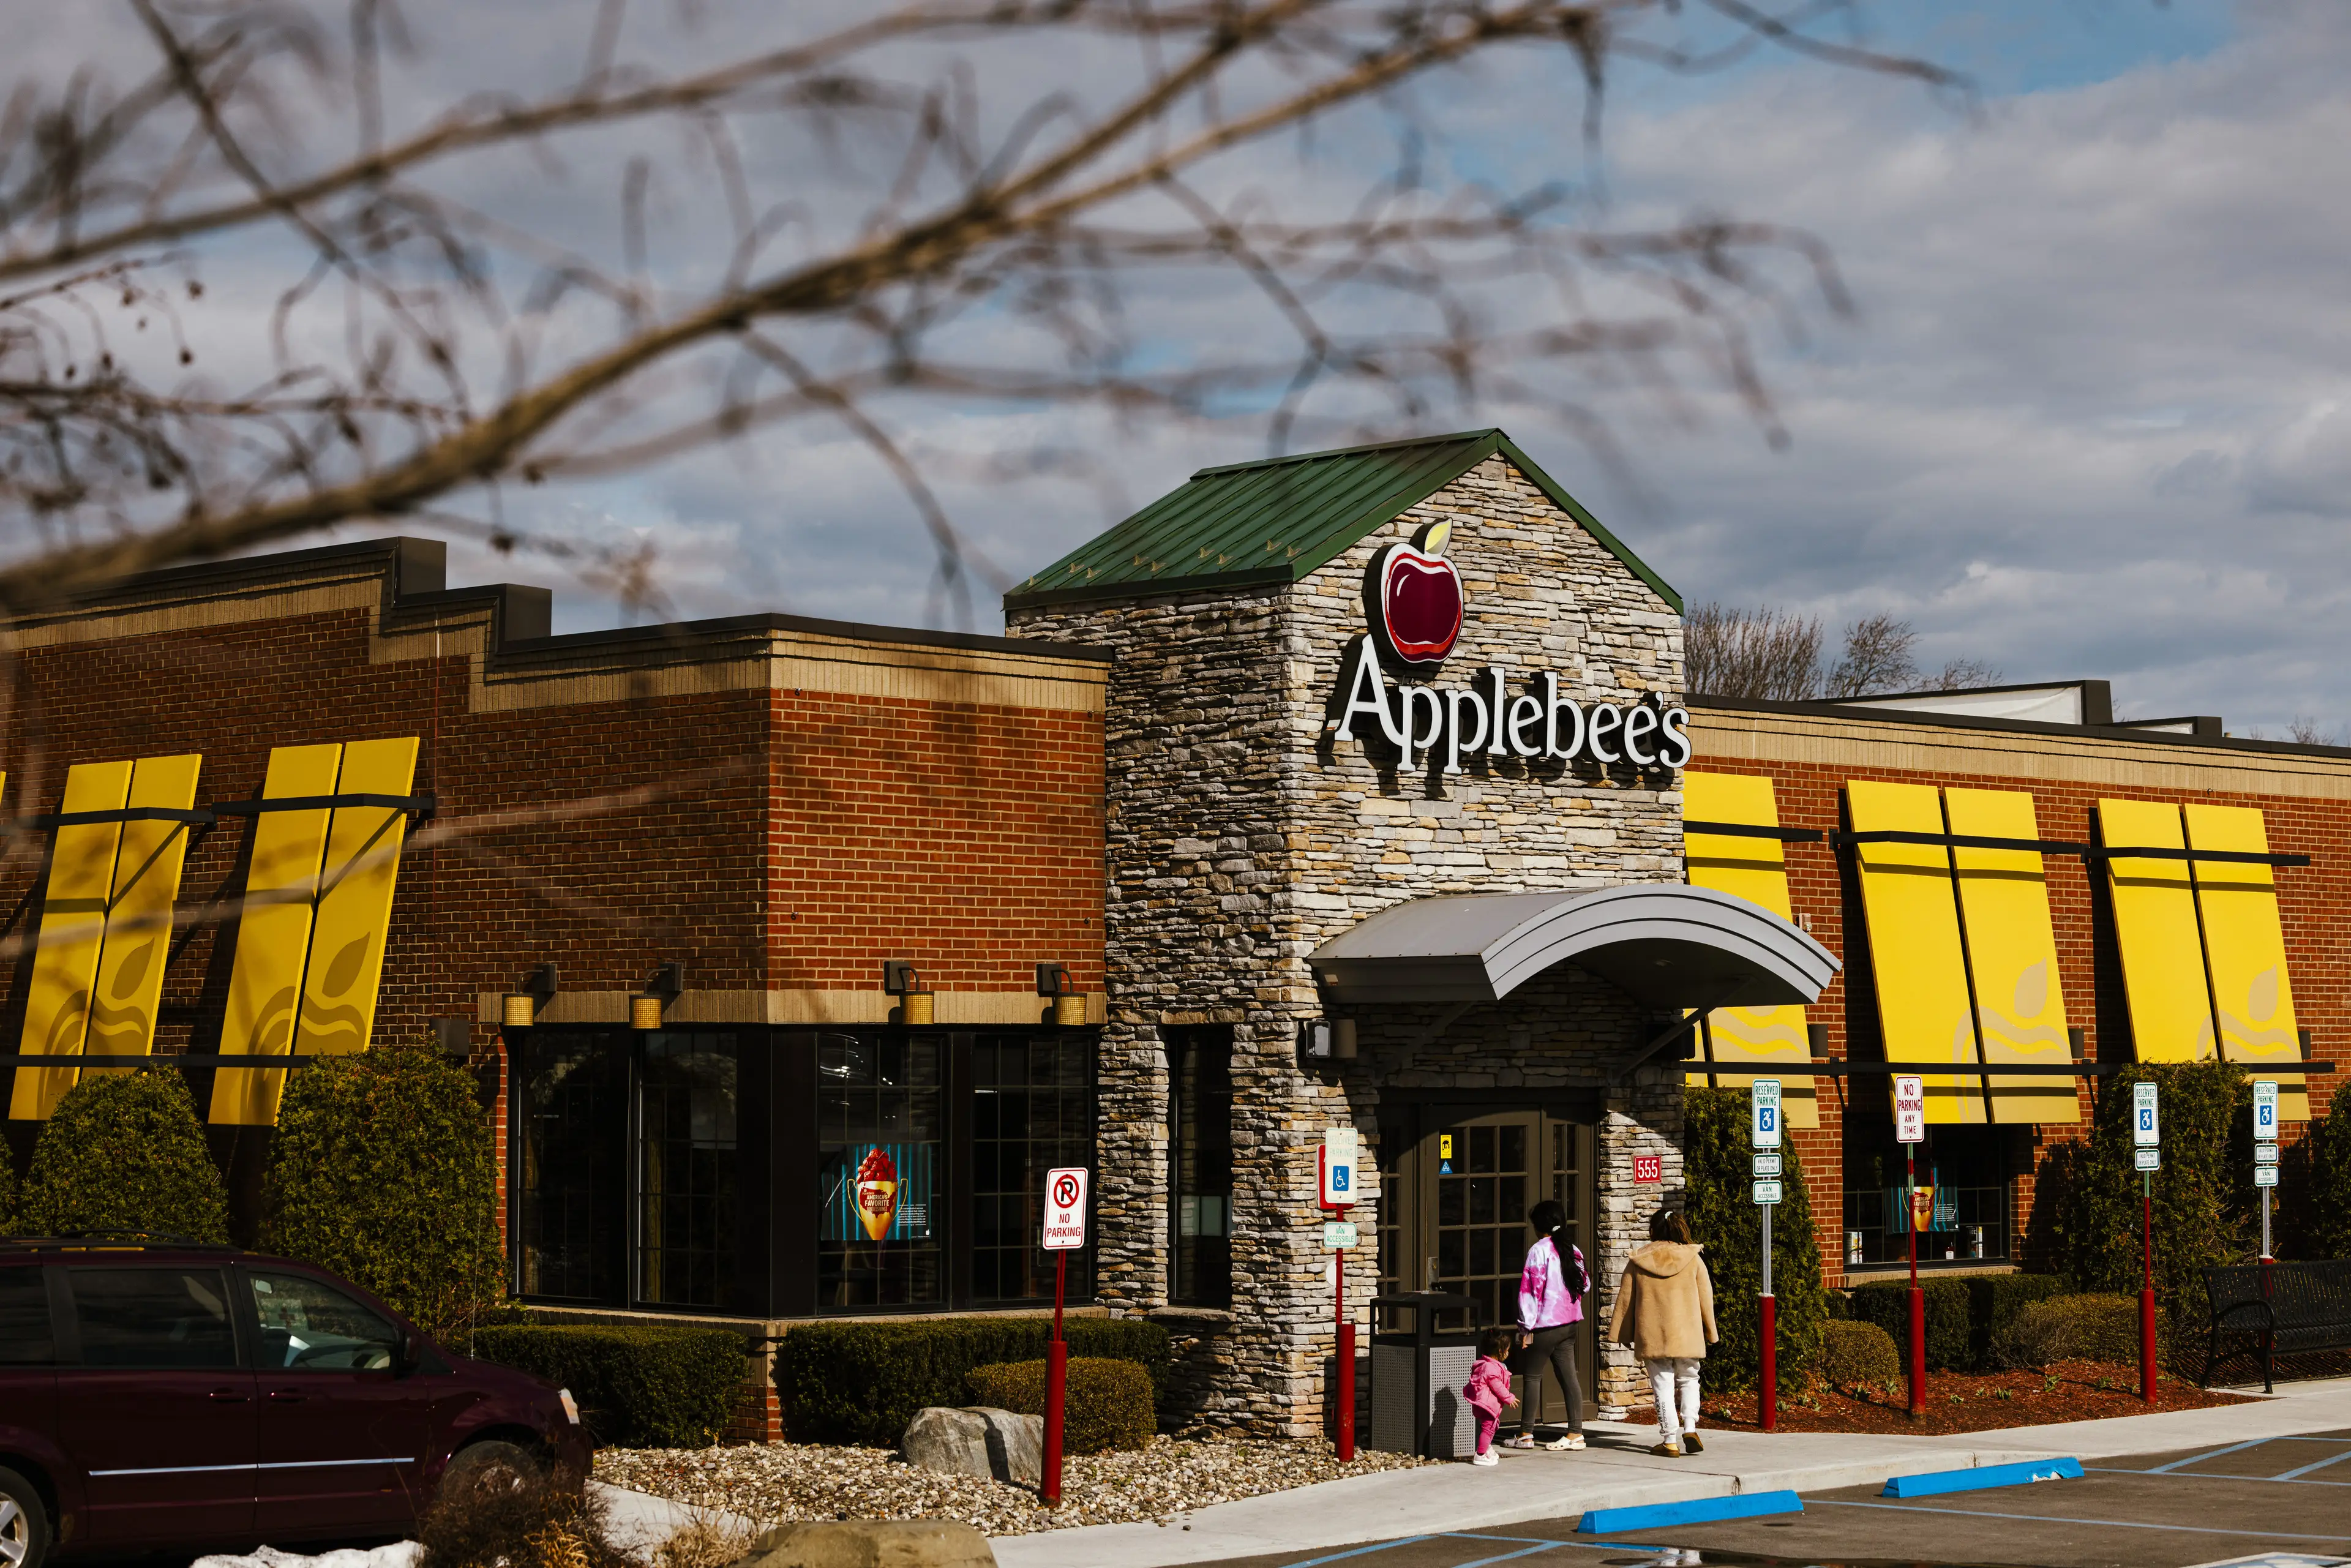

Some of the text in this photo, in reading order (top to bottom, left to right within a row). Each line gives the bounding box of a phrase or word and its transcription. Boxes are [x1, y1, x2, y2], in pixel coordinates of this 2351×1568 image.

[1335, 634, 1692, 774] Applebee's
[1755, 1086, 1779, 1095] RESERVED
[1904, 1084, 1914, 1096] NO
[2135, 1089, 2154, 1097] RESERVED
[2256, 1086, 2275, 1095] RESERVED
[1757, 1097, 1777, 1106] PARKING
[2137, 1099, 2154, 1108] PARKING
[2258, 1095, 2274, 1104] PARKING
[1898, 1099, 1921, 1111] PARKING
[1328, 1136, 1355, 1145] RESERVED
[1329, 1148, 1353, 1158] PARKING
[1638, 1160, 1658, 1179] 555
[1059, 1214, 1070, 1223] NO
[1047, 1226, 1081, 1237] PARKING
